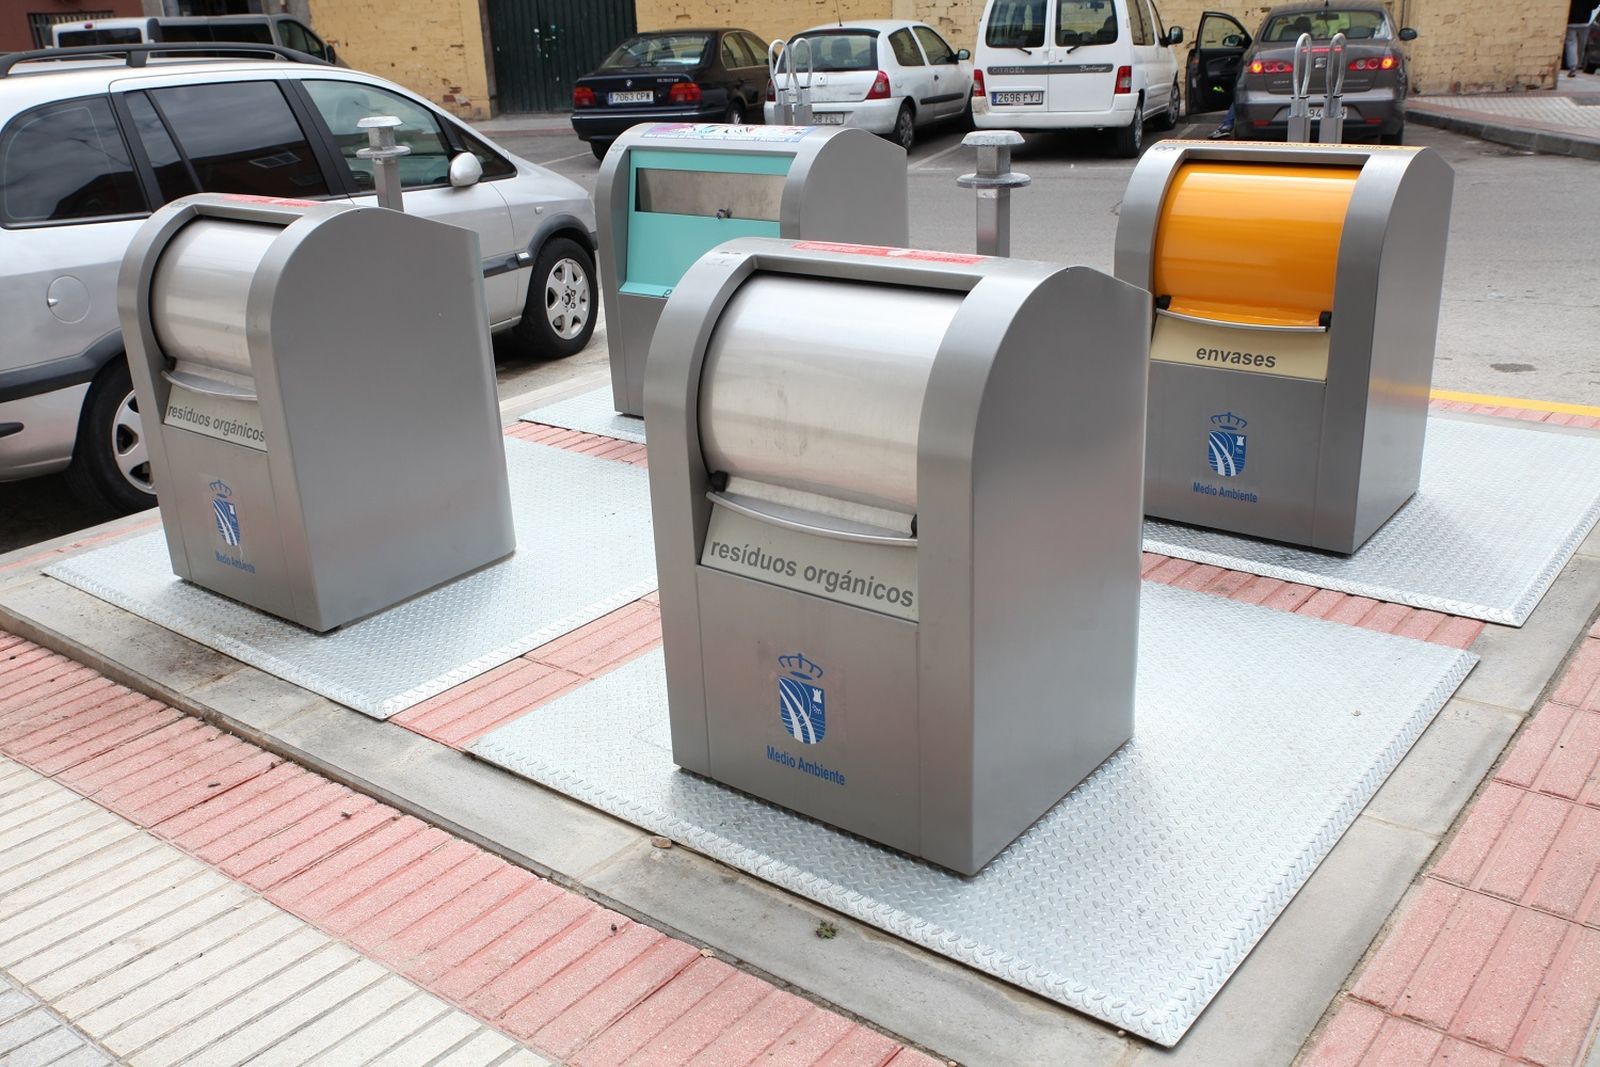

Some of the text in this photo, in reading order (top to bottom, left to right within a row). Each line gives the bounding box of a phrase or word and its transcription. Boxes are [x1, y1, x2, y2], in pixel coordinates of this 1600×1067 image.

[615, 93, 634, 102] 7063
[998, 92, 1041, 103] 2696 FYJ
[1197, 347, 1276, 368] envases
[168, 405, 265, 442] resíduos orgánicos
[1194, 482, 1258, 503] Medio Ambiente
[710, 540, 914, 608] resíduos orgánicos
[767, 745, 846, 786] Medio Ambiente
